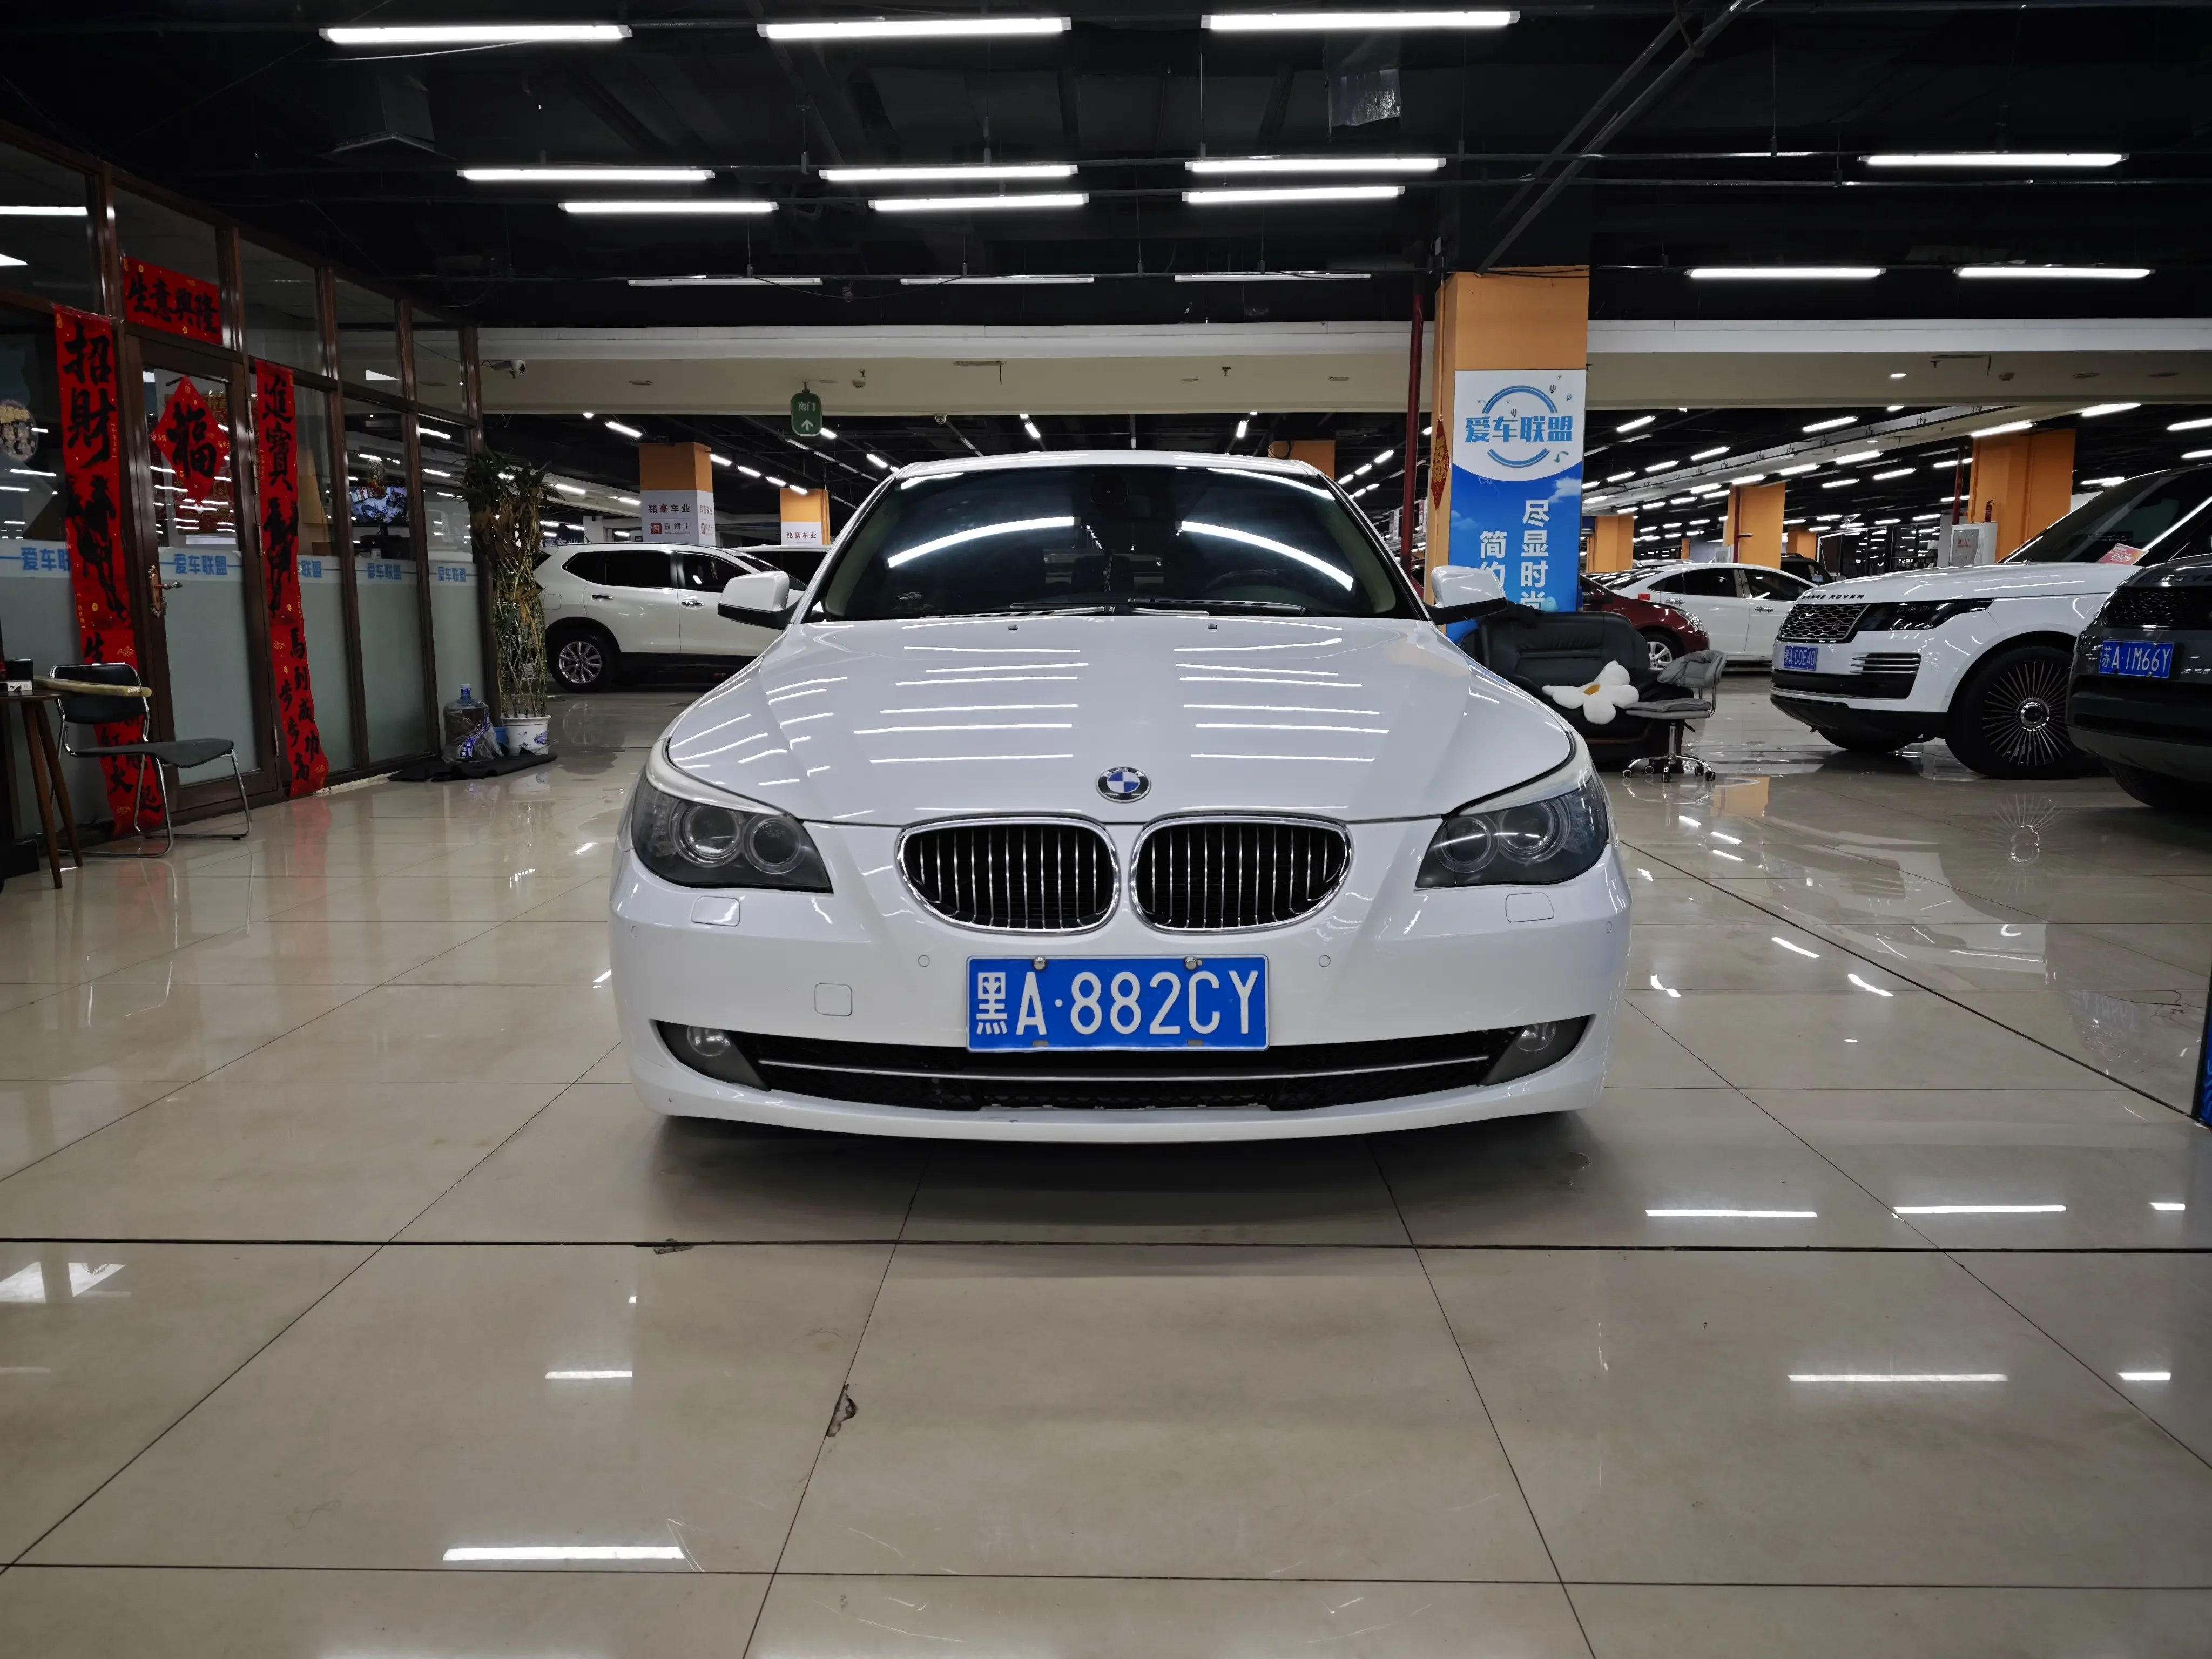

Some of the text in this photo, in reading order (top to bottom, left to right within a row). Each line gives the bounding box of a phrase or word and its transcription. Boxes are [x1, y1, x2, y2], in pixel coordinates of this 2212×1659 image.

[798, 402, 815, 411] 南门
[1465, 416, 1573, 443] 爱车联盟
[166, 402, 216, 478] 福
[648, 504, 690, 513] 铭豪车业
[21, 547, 71, 571] 爱车联
[1520, 500, 1550, 611] 尽显时尚
[173, 554, 228, 576] 爱车联盟
[299, 560, 322, 578] 联盟
[367, 563, 402, 581] 爱车联盟
[437, 567, 467, 582] 爱车联盟
[1101, 767, 1144, 778] BMW
